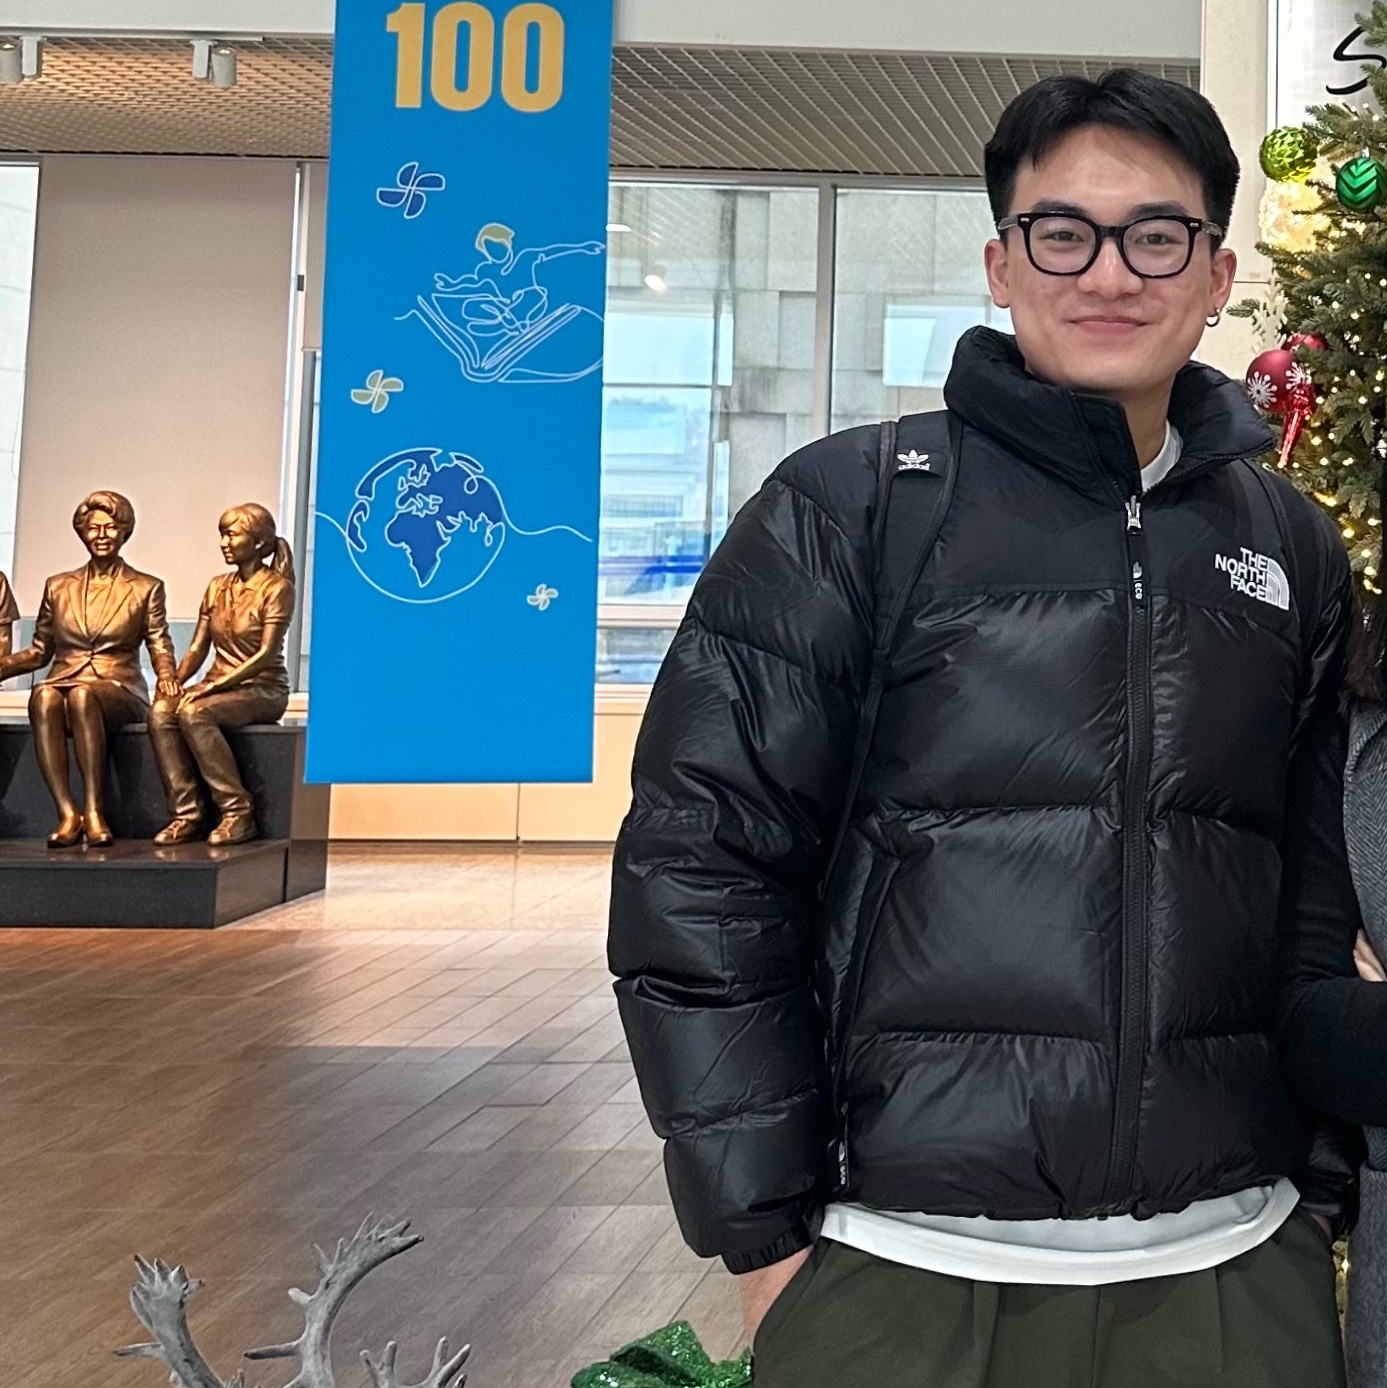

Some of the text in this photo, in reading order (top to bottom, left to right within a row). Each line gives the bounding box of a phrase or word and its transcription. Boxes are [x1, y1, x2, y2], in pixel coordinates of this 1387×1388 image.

[386, 1, 565, 113] 100
[1214, 553, 1266, 586] NORTH
[1240, 546, 1269, 572] THE
[1230, 574, 1267, 602] FACE
